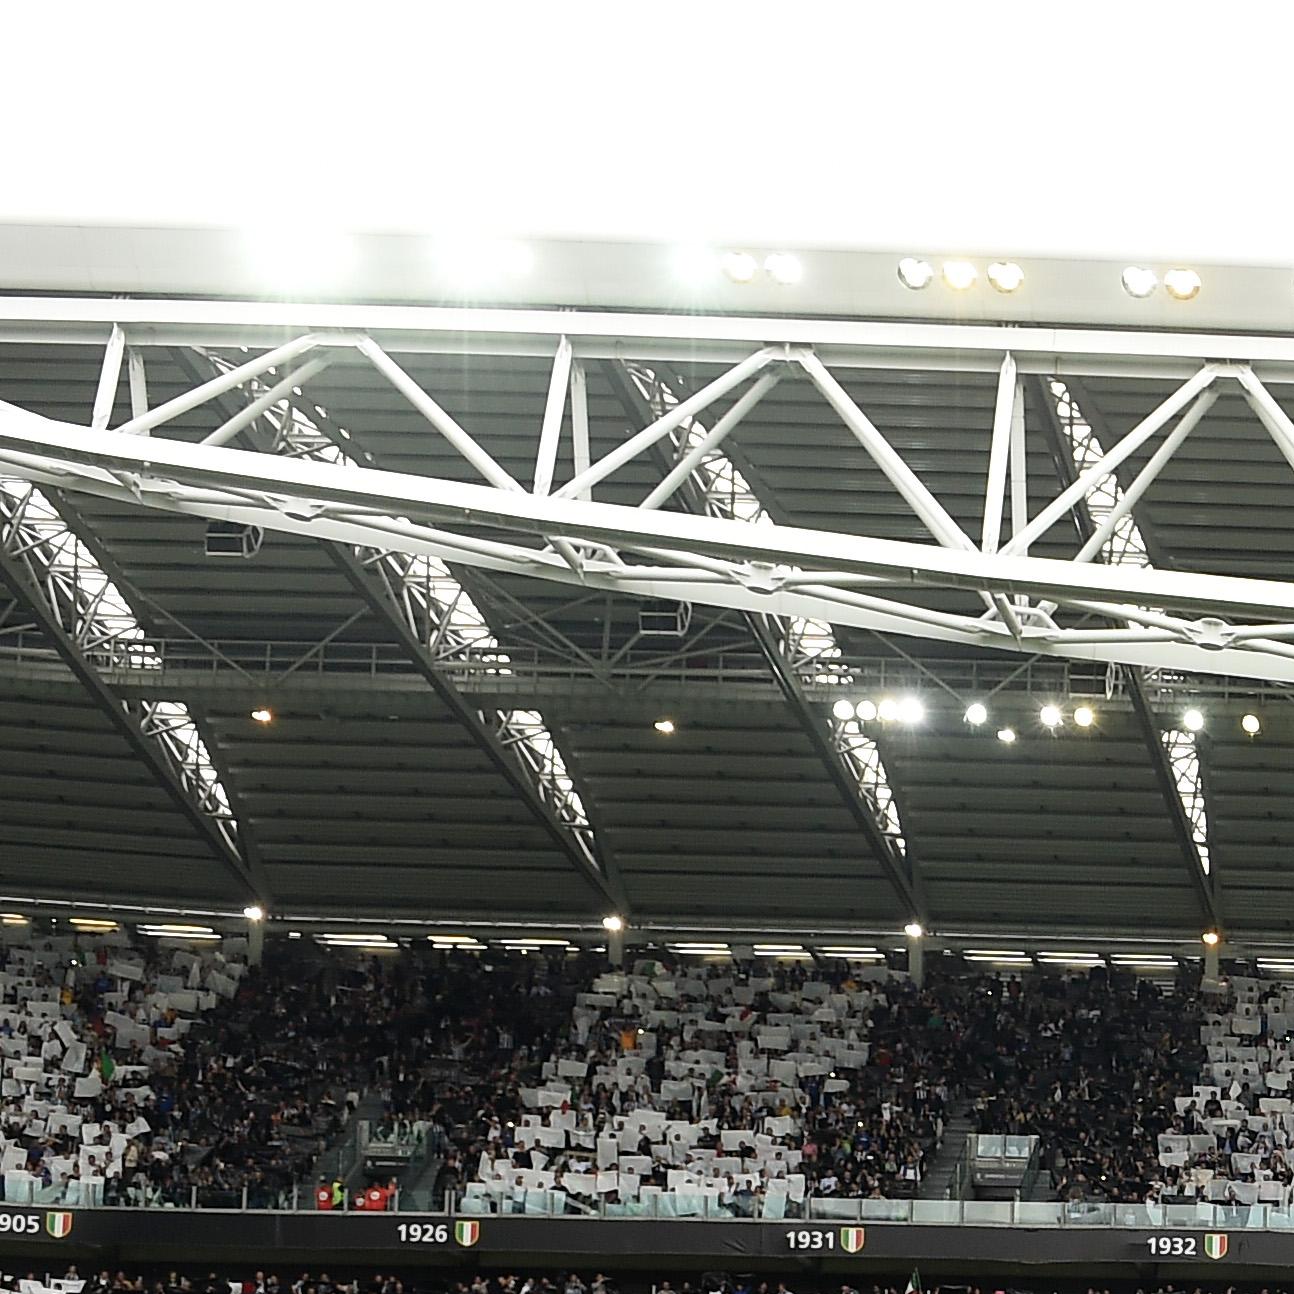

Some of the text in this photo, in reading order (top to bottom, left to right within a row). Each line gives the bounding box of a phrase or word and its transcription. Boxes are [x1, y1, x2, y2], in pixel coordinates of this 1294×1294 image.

[397, 1223, 448, 1243] 1926
[786, 1230, 834, 1249] 1931
[1146, 1236, 1197, 1256] 1932
